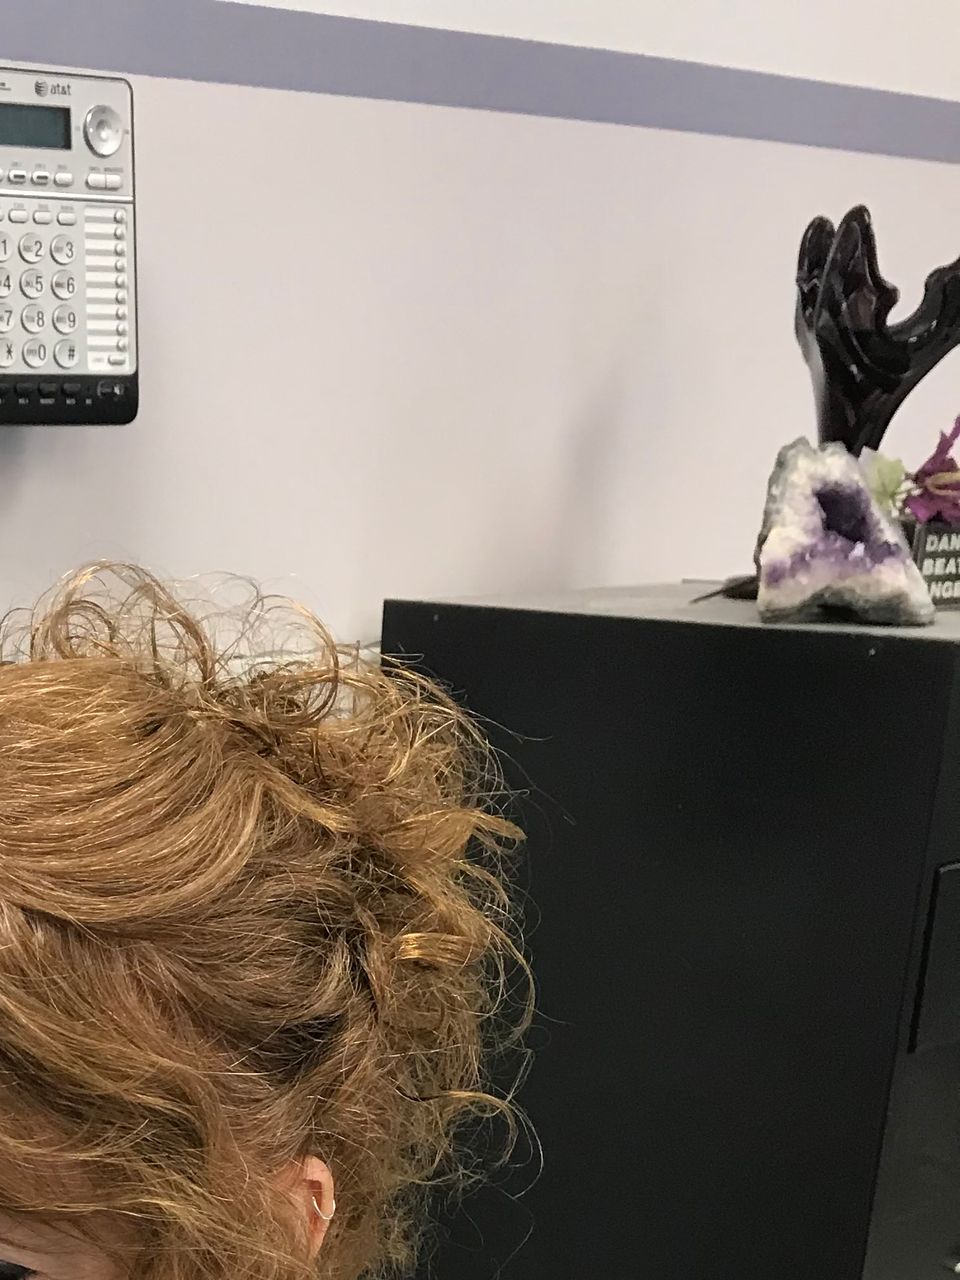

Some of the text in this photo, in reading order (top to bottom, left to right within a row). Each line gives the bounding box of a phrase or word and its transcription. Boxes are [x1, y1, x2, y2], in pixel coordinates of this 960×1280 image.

[50, 83, 72, 96] at&t
[1, 239, 7, 255] 1
[34, 240, 43, 257] 2
[65, 242, 74, 258] 3
[3, 274, 11, 291] 4
[35, 276, 43, 292] 5
[67, 277, 75, 293] 6
[4, 310, 13, 326] 7
[36, 311, 45, 327] 8
[68, 312, 76, 328] 9
[38, 344, 47, 361] 0
